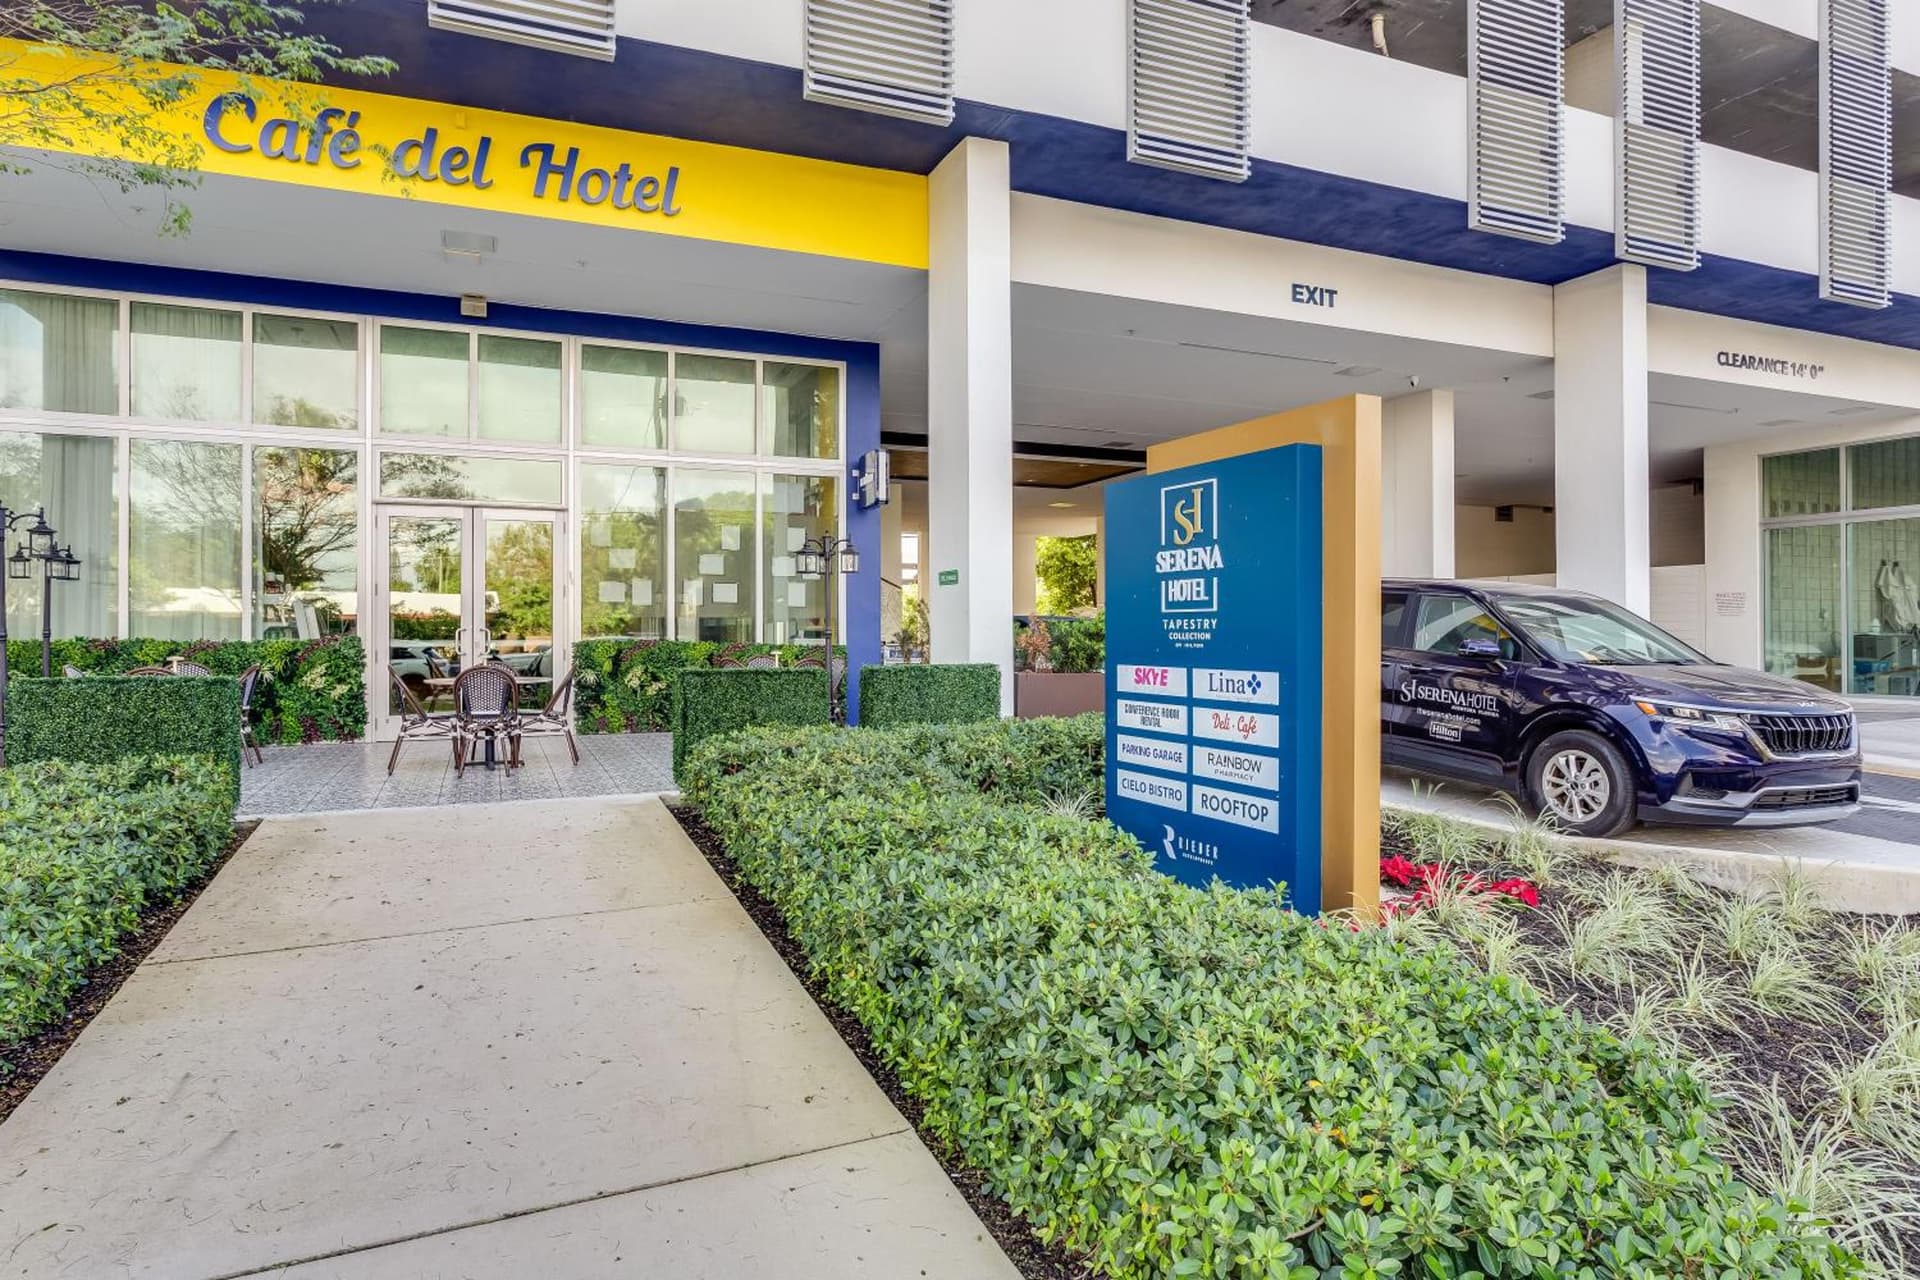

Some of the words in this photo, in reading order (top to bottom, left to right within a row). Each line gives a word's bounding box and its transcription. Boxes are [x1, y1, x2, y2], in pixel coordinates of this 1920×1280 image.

[203, 92, 361, 169] Café
[392, 127, 493, 189] del
[520, 143, 681, 216] Hotel
[1291, 283, 1338, 308] EXIT
[1717, 351, 1789, 376] CLEARANCE
[1155, 544, 1224, 572] SERENA
[1168, 578, 1209, 602] HOTEL
[1162, 618, 1217, 630] TAPESTRY
[1168, 631, 1212, 640] COLLECTION
[1134, 667, 1169, 687] SKYE
[1208, 671, 1246, 695] Lina
[1124, 703, 1161, 717] CONFERENCE
[1161, 707, 1180, 720] ROOM
[1212, 712, 1230, 730] Deli
[1432, 724, 1459, 738] Hilton
[1122, 743, 1151, 758] PARKING
[1152, 748, 1183, 763] GARAGE
[1214, 768, 1254, 781] PHARMACY
[1121, 778, 1147, 793] CIELO
[1148, 783, 1183, 802] BISTRO
[1201, 793, 1269, 823] ROOFTOP
